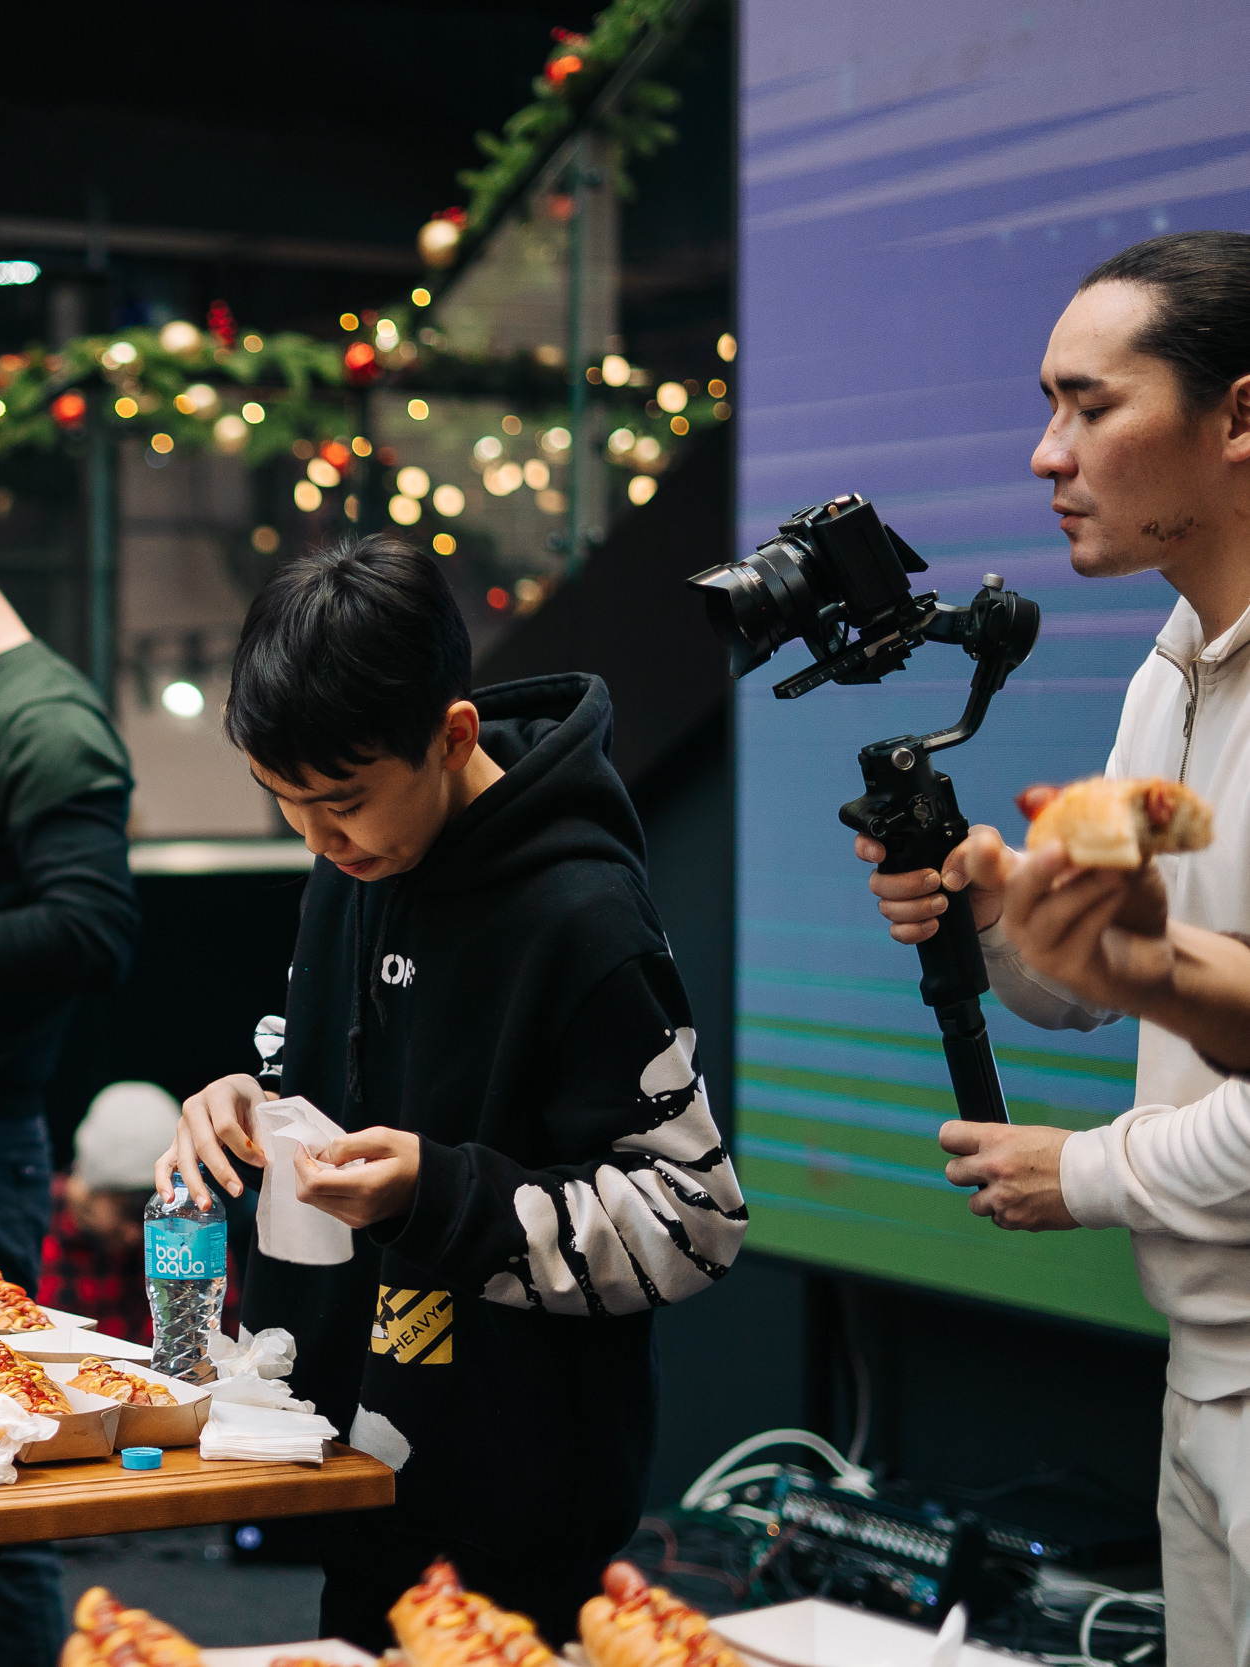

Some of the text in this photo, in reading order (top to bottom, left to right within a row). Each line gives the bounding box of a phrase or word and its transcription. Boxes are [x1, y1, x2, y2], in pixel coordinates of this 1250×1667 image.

[155, 1243, 192, 1261] bon
[156, 1260, 205, 1277] aqua
[391, 1306, 440, 1354] HEAVY
